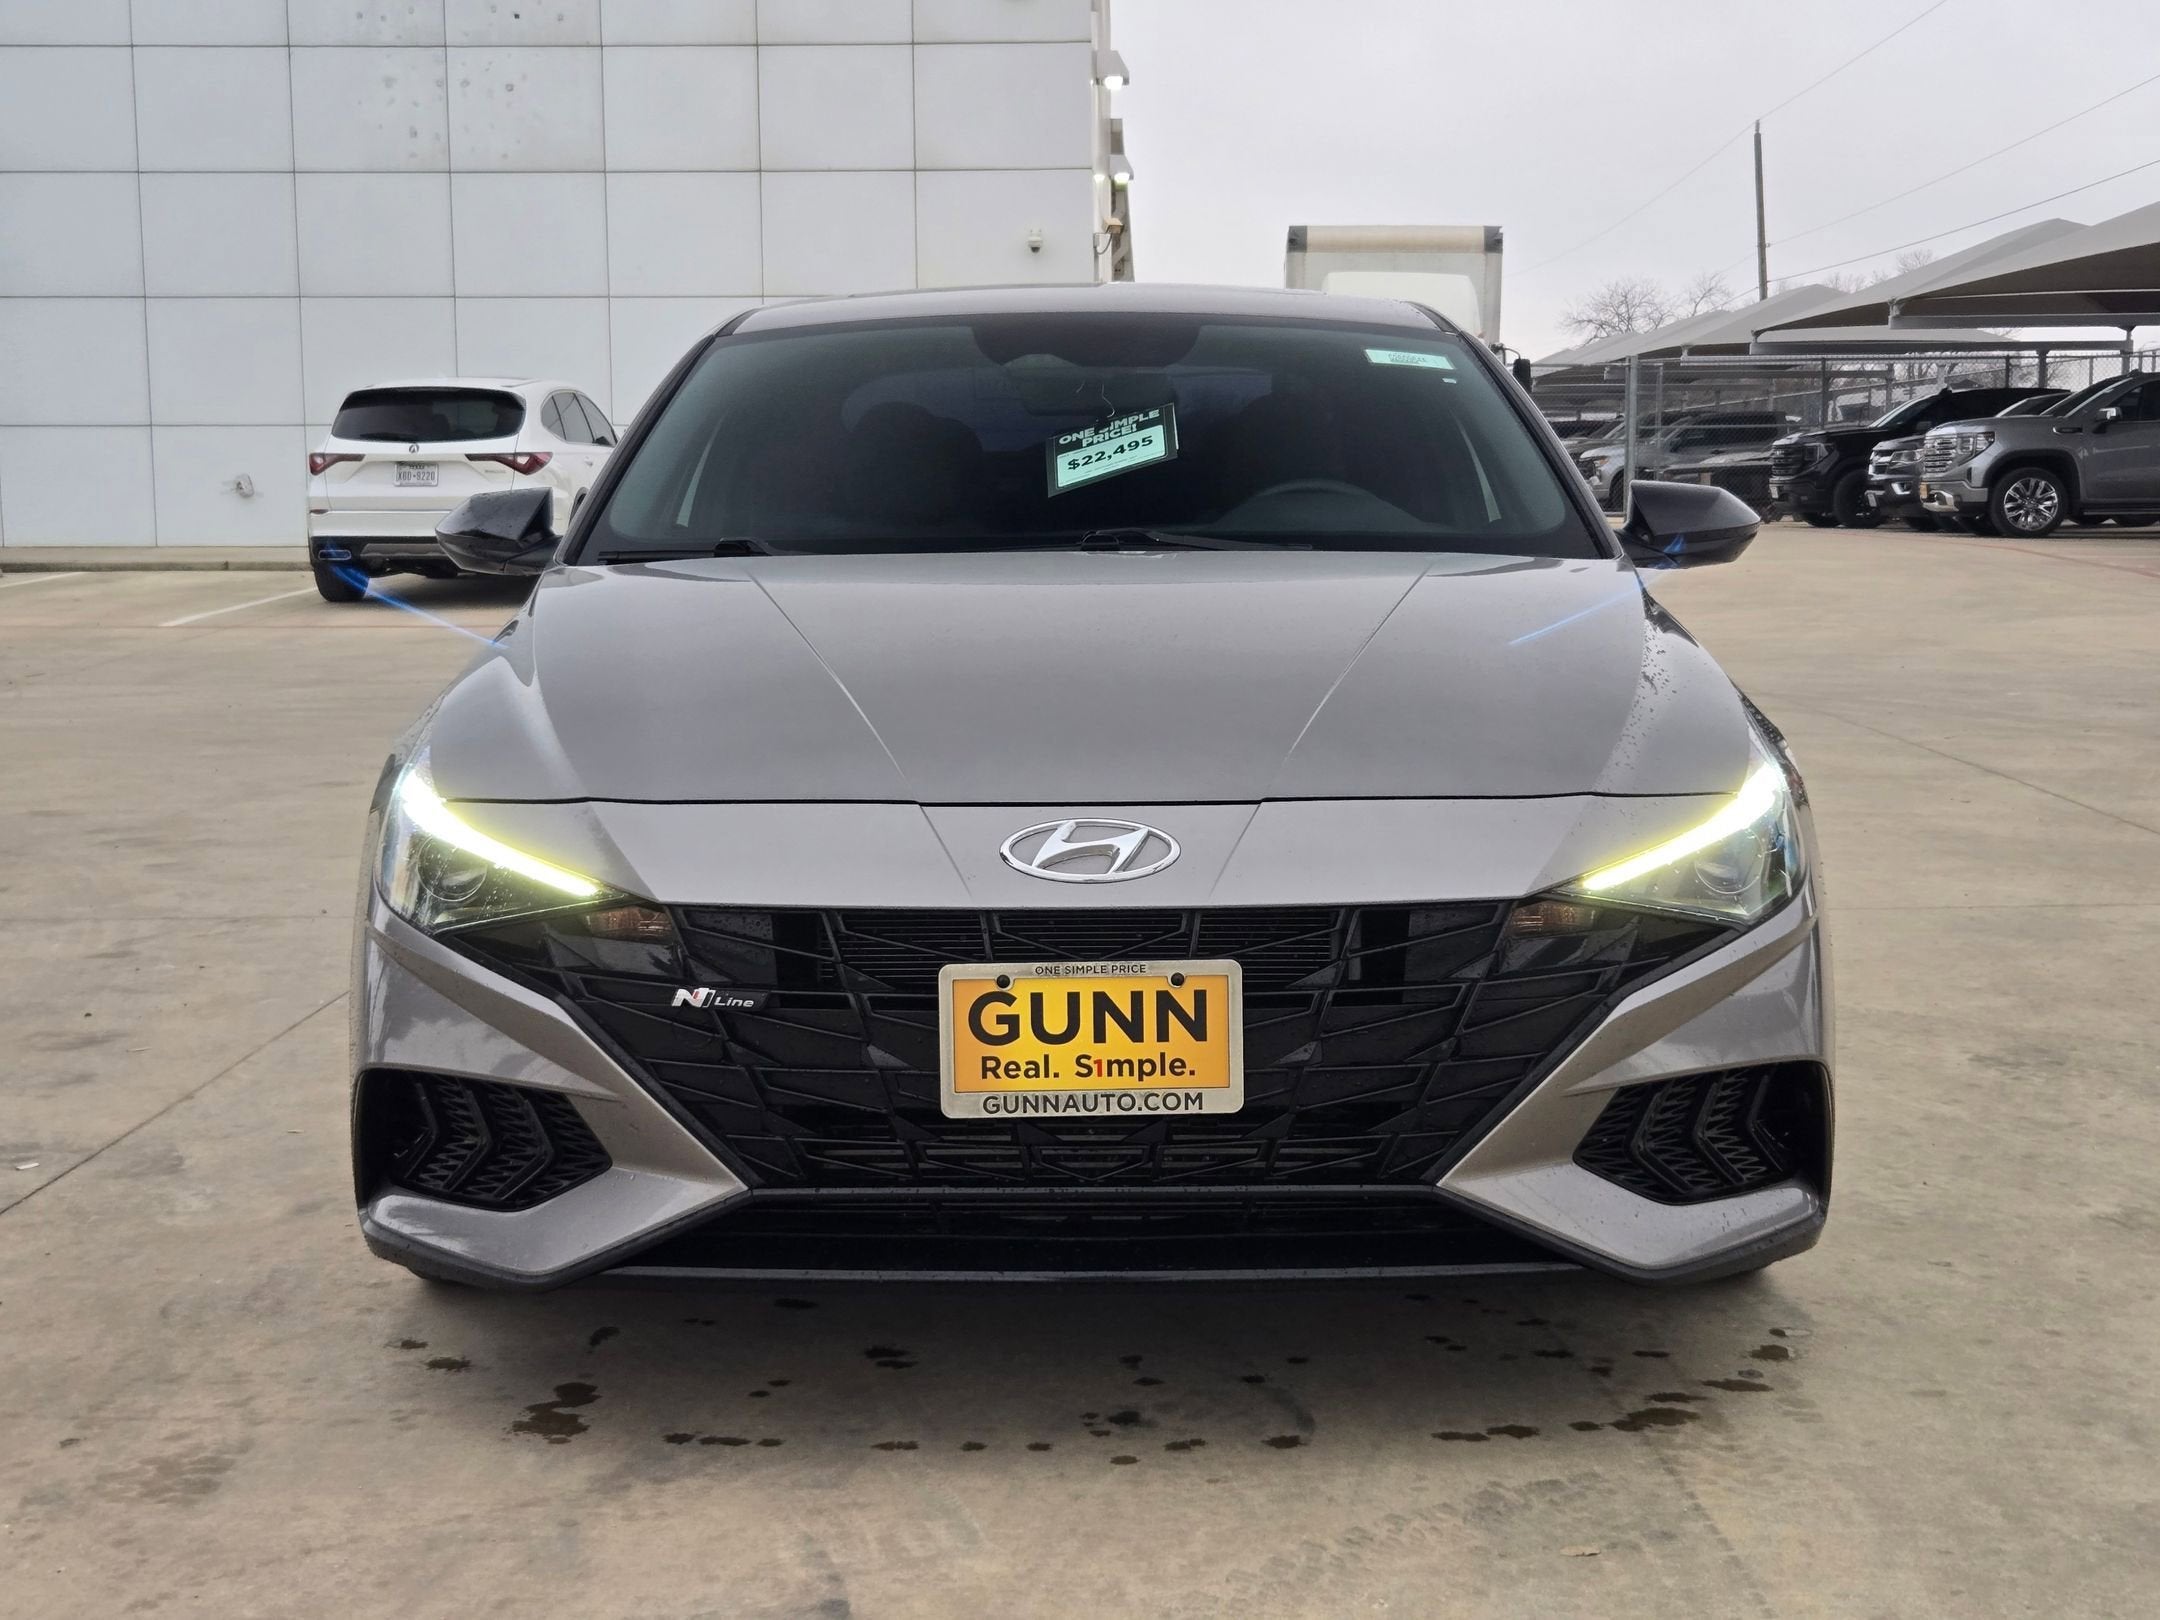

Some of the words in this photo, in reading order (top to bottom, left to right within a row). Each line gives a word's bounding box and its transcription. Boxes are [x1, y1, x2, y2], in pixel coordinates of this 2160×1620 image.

[1059, 427, 1095, 444] ONE
[1082, 423, 1138, 447] PRICE!
[1067, 435, 1153, 470] $22,495
[1035, 965, 1061, 975] ONE
[1064, 965, 1108, 975] SIMPLE
[1111, 964, 1147, 974] PRICE
[671, 987, 717, 1008] N
[714, 997, 754, 1008] Line
[968, 989, 1208, 1046] GUNN
[981, 1054, 1060, 1079] Real.
[983, 1092, 1204, 1115] GUNNAUTO.COM
